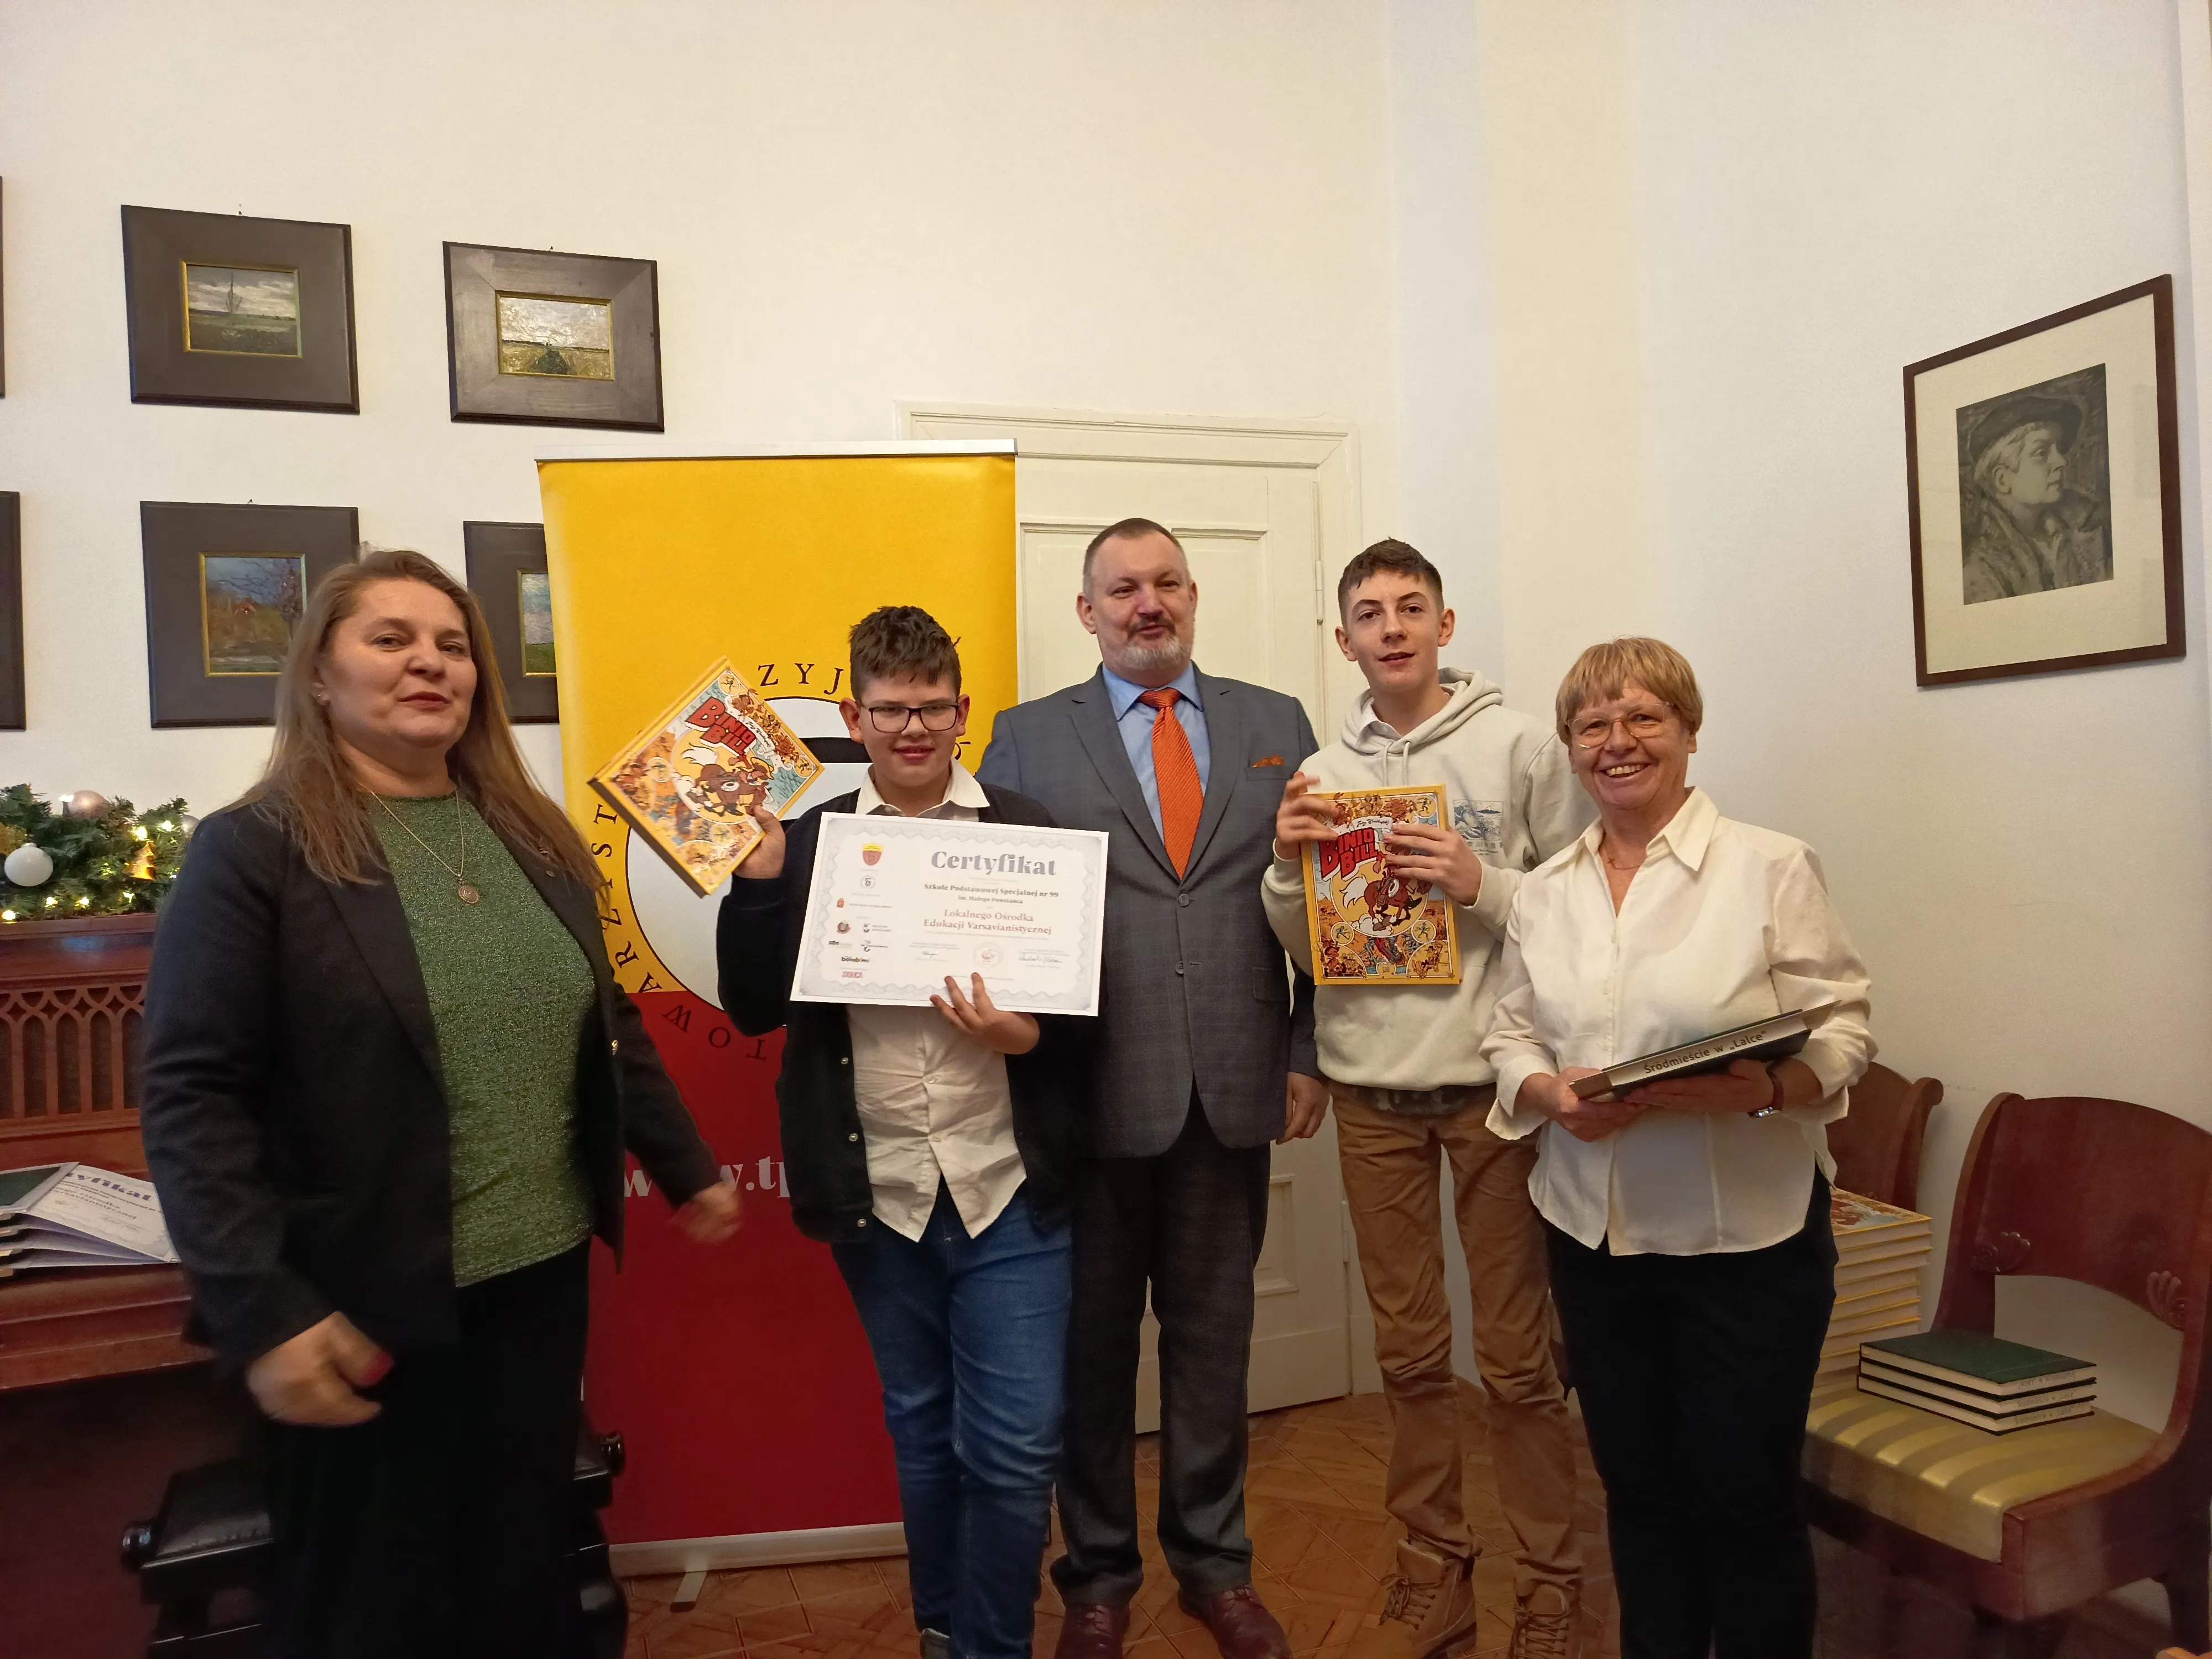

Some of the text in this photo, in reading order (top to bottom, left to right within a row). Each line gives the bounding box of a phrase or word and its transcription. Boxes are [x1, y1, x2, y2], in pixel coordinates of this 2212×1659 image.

[685, 696, 757, 744] BINIO
[699, 724, 749, 756] BILL
[931, 851, 1057, 876] Certyfikat
[1318, 827, 1375, 879] BINIO
[1339, 842, 1379, 880] BILL
[950, 885, 999, 895] Podstawowej
[1000, 888, 1038, 898] Specjalnej
[923, 919, 965, 930] Edukacji
[967, 921, 1052, 935] Varsavianistycznej
[944, 909, 1034, 922] Lokalnego Ośrodka
[1644, 1049, 1710, 1074] Śródmieście
[1714, 1045, 1724, 1053] w
